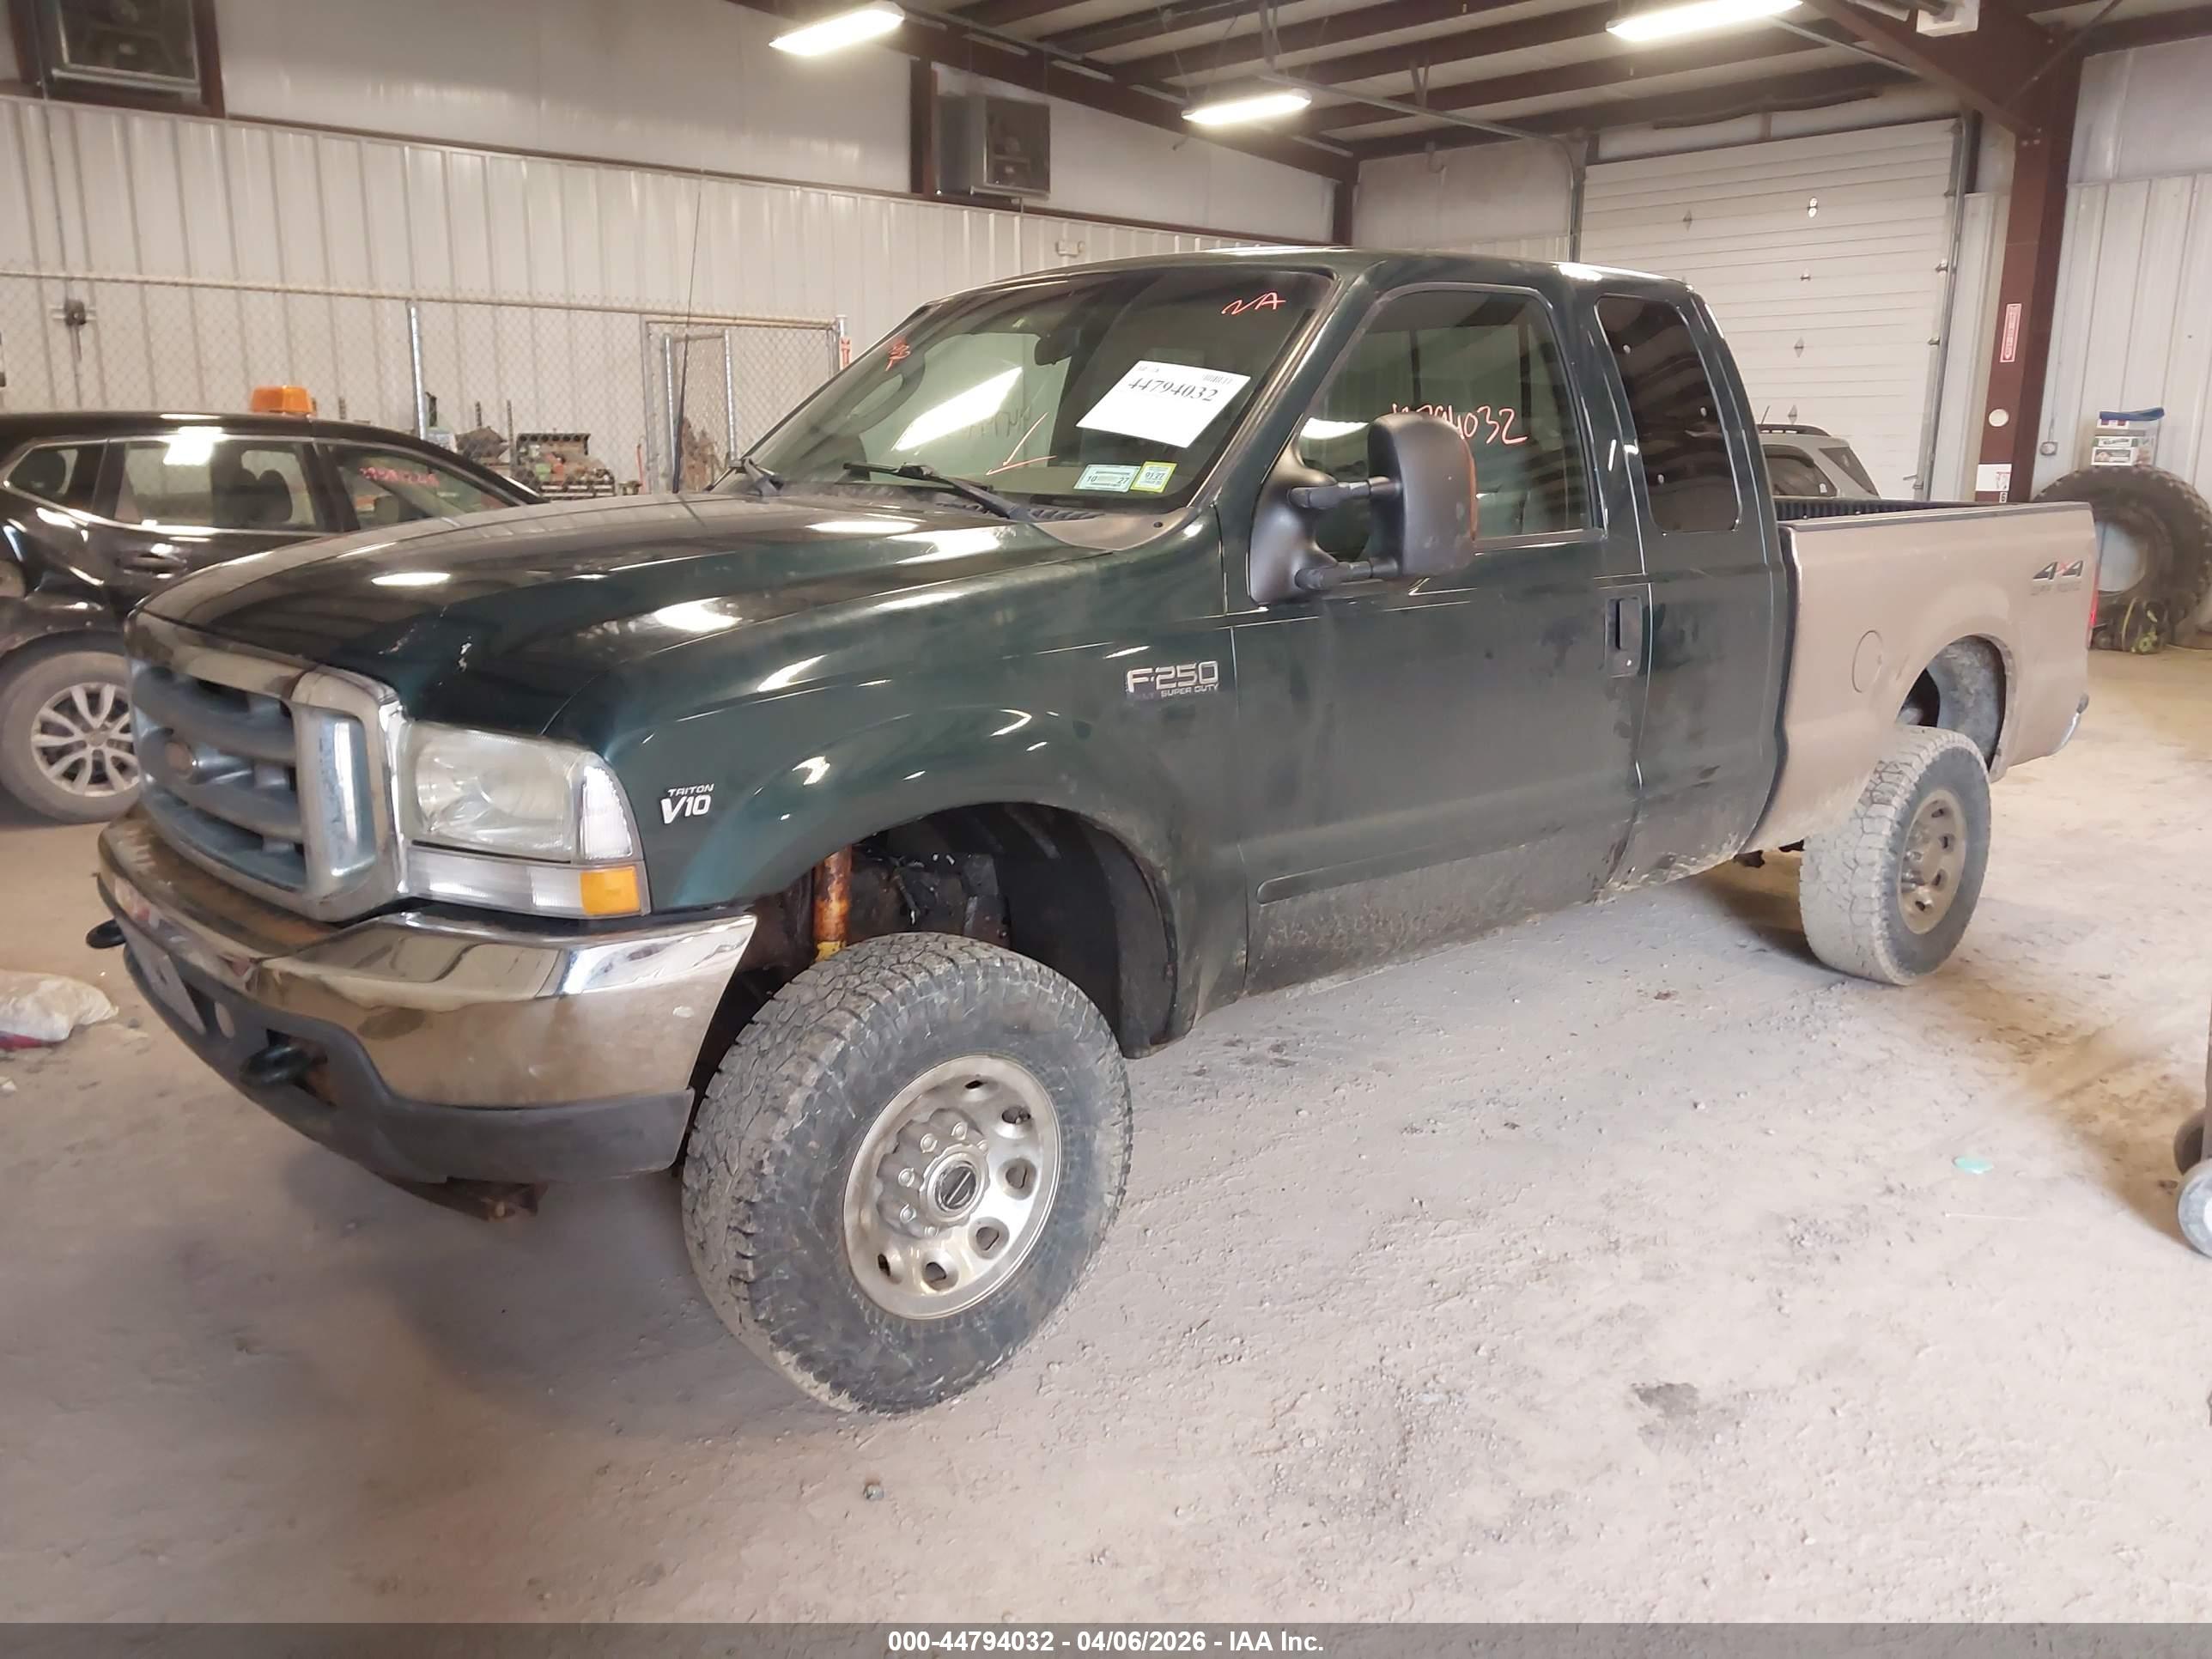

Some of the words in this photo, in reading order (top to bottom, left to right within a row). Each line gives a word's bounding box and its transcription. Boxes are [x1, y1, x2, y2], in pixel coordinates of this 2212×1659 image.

[1127, 377, 1218, 402] 44794032
[1160, 687, 1192, 698] SUPER
[1194, 684, 1219, 693] DUTY
[667, 783, 714, 797] TRITON
[660, 794, 712, 824] V10
